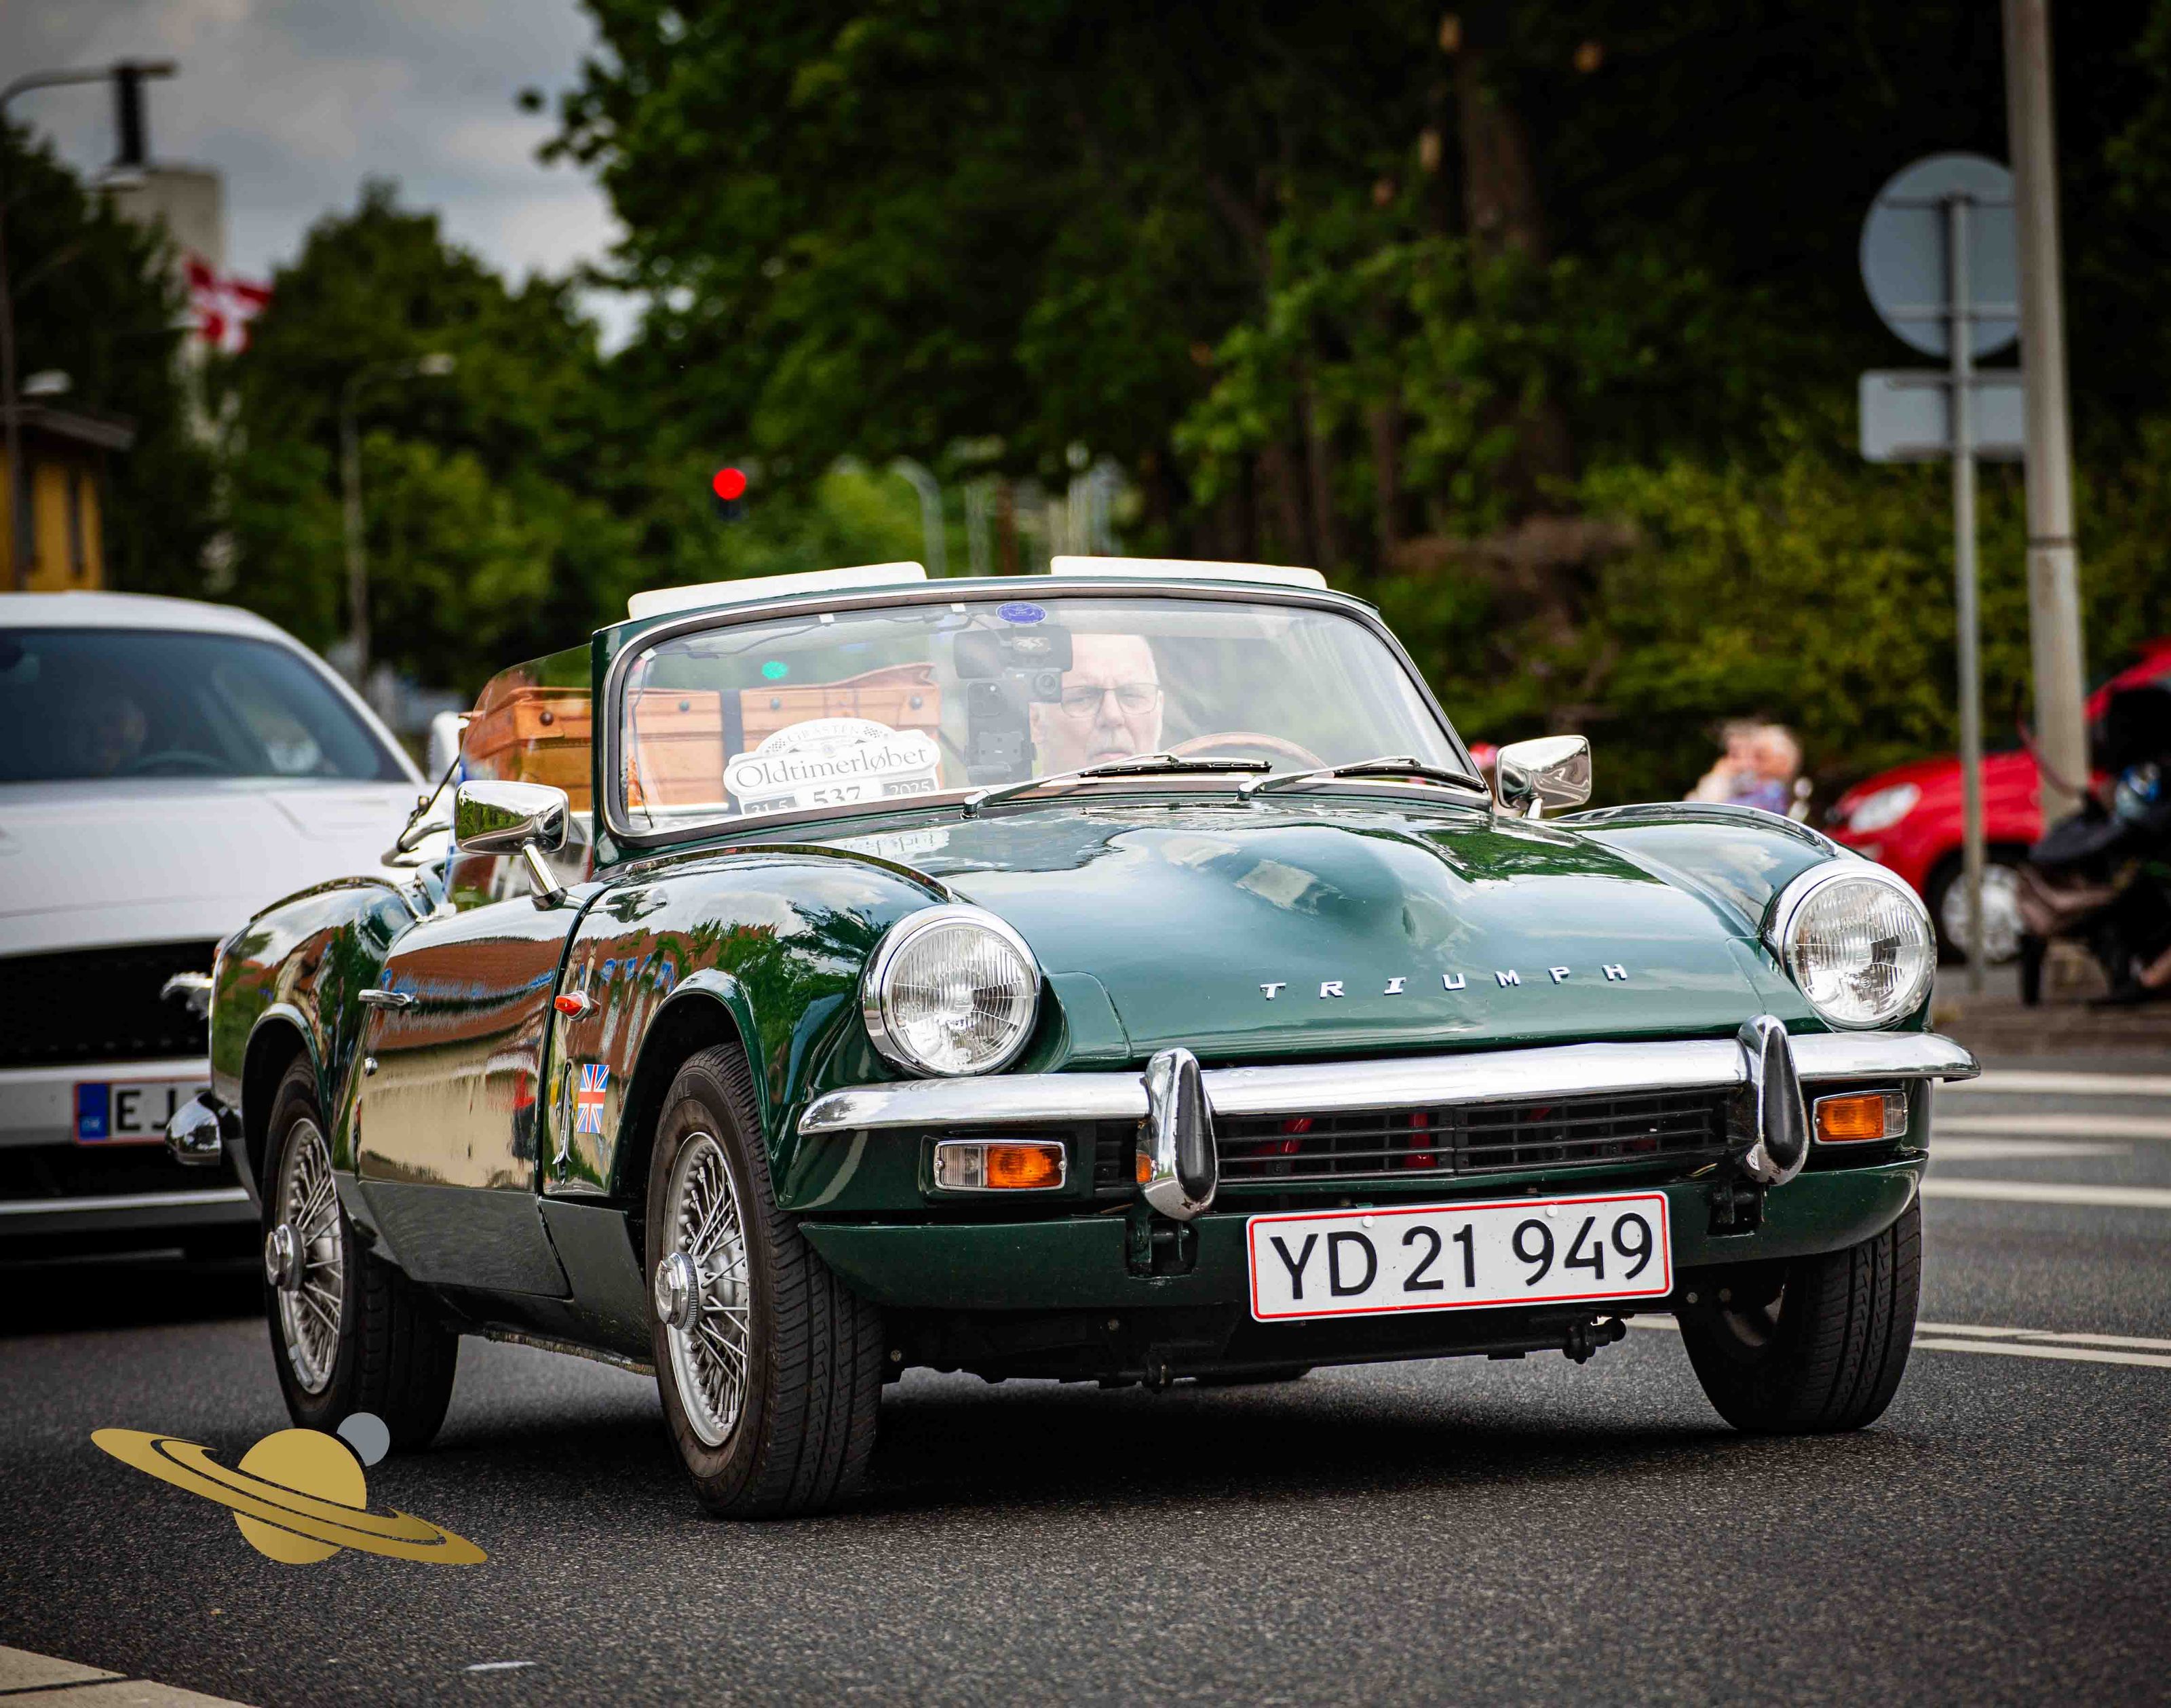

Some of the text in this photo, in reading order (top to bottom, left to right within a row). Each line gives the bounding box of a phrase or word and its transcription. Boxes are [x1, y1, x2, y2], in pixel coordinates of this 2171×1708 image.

[736, 746, 927, 788] Oldtimerløbet
[813, 786, 860, 804] 537
[1259, 963, 1628, 1001] TRIUMPH
[1270, 1211, 1653, 1300] YD 21 949
